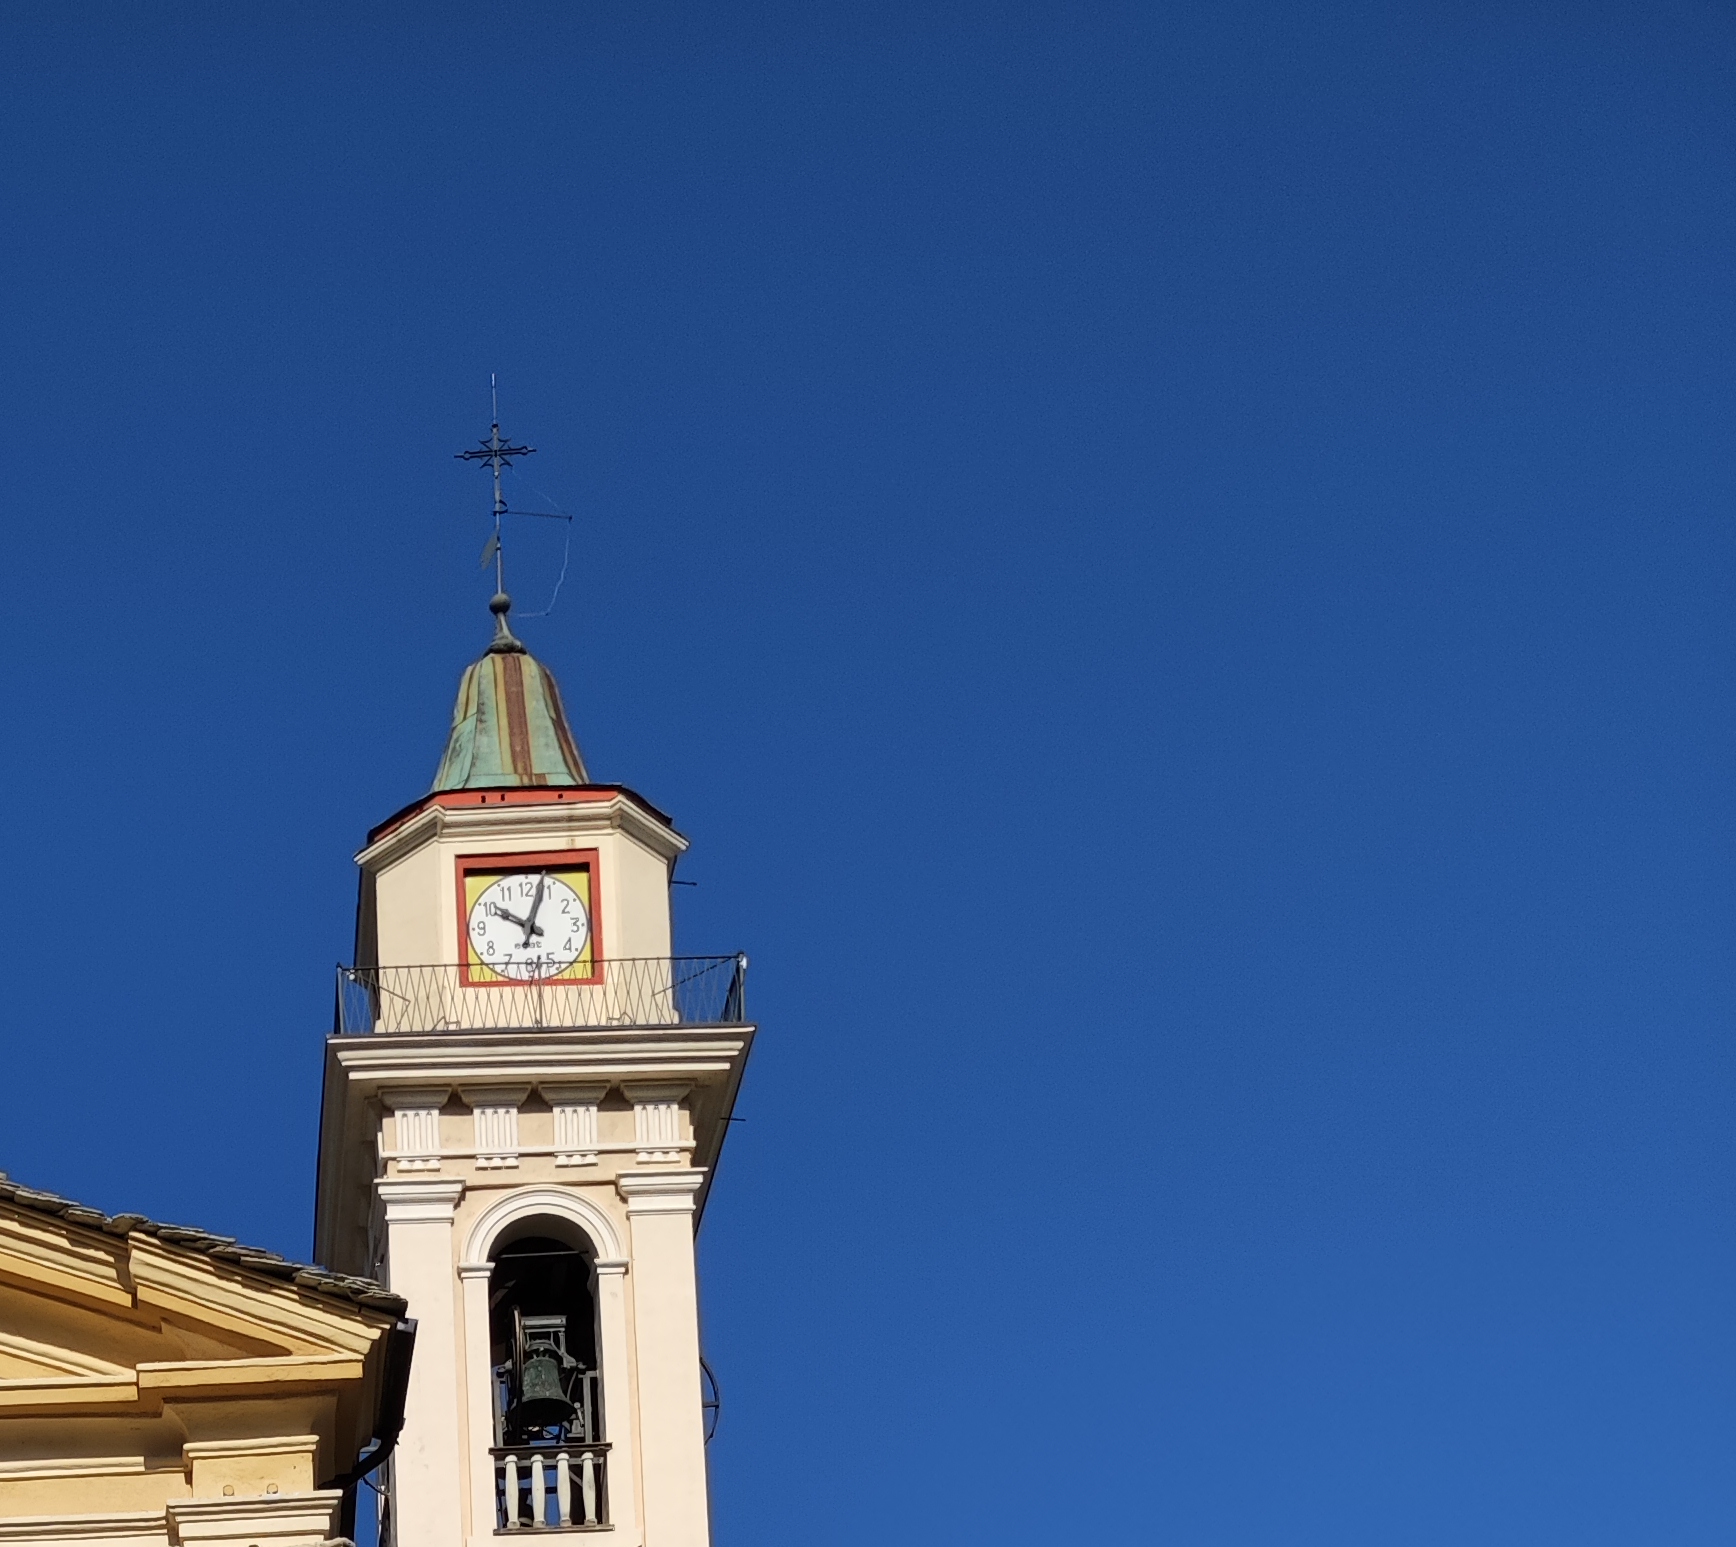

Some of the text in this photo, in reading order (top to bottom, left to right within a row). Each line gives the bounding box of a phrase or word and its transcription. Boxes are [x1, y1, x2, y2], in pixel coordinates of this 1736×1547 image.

[500, 886, 512, 902] 11
[519, 882, 534, 898] 12
[546, 884, 552, 900] 1
[483, 901, 497, 917] 10
[560, 899, 570, 915] 2
[477, 921, 486, 936] 9
[570, 917, 580, 933] 3
[486, 940, 496, 956] 8
[563, 937, 572, 953] 4
